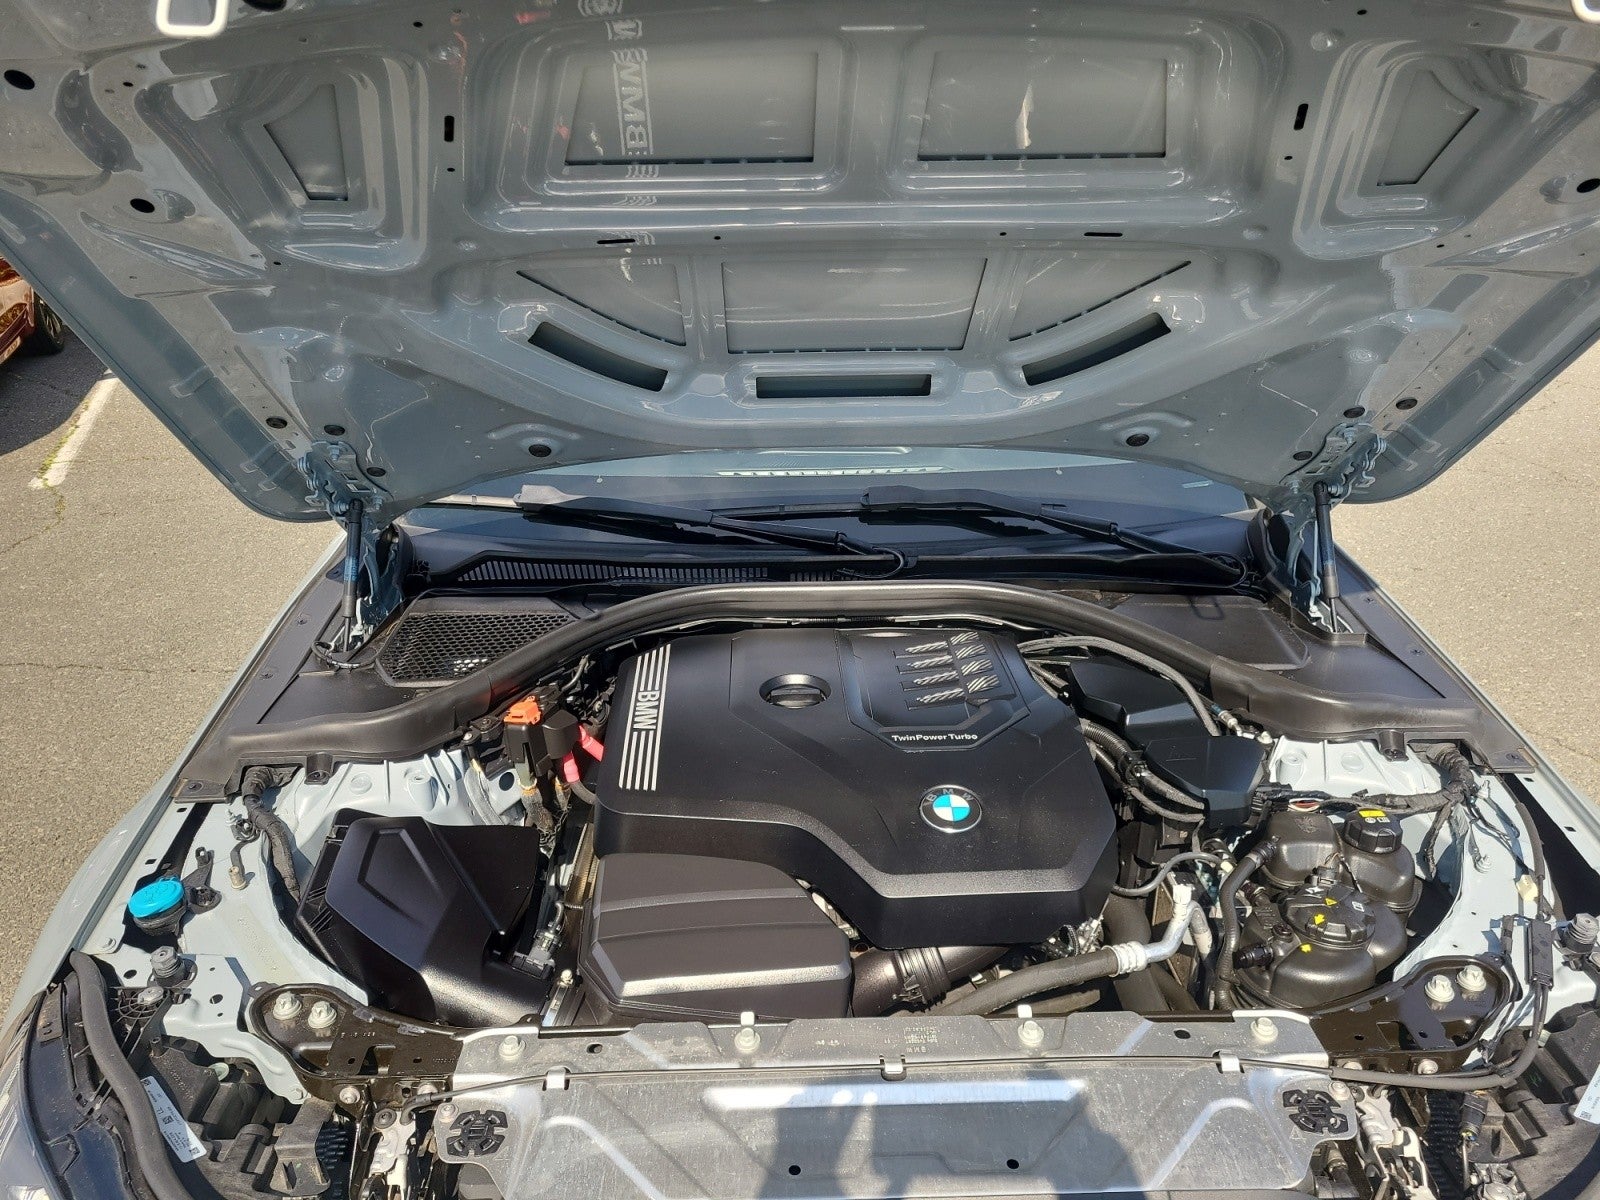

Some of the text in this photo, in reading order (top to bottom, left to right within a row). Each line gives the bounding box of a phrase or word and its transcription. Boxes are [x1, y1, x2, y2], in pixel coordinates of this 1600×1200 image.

[632, 691, 661, 729] BMW
[948, 733, 978, 741] Turbo
[926, 788, 974, 802] BMW
